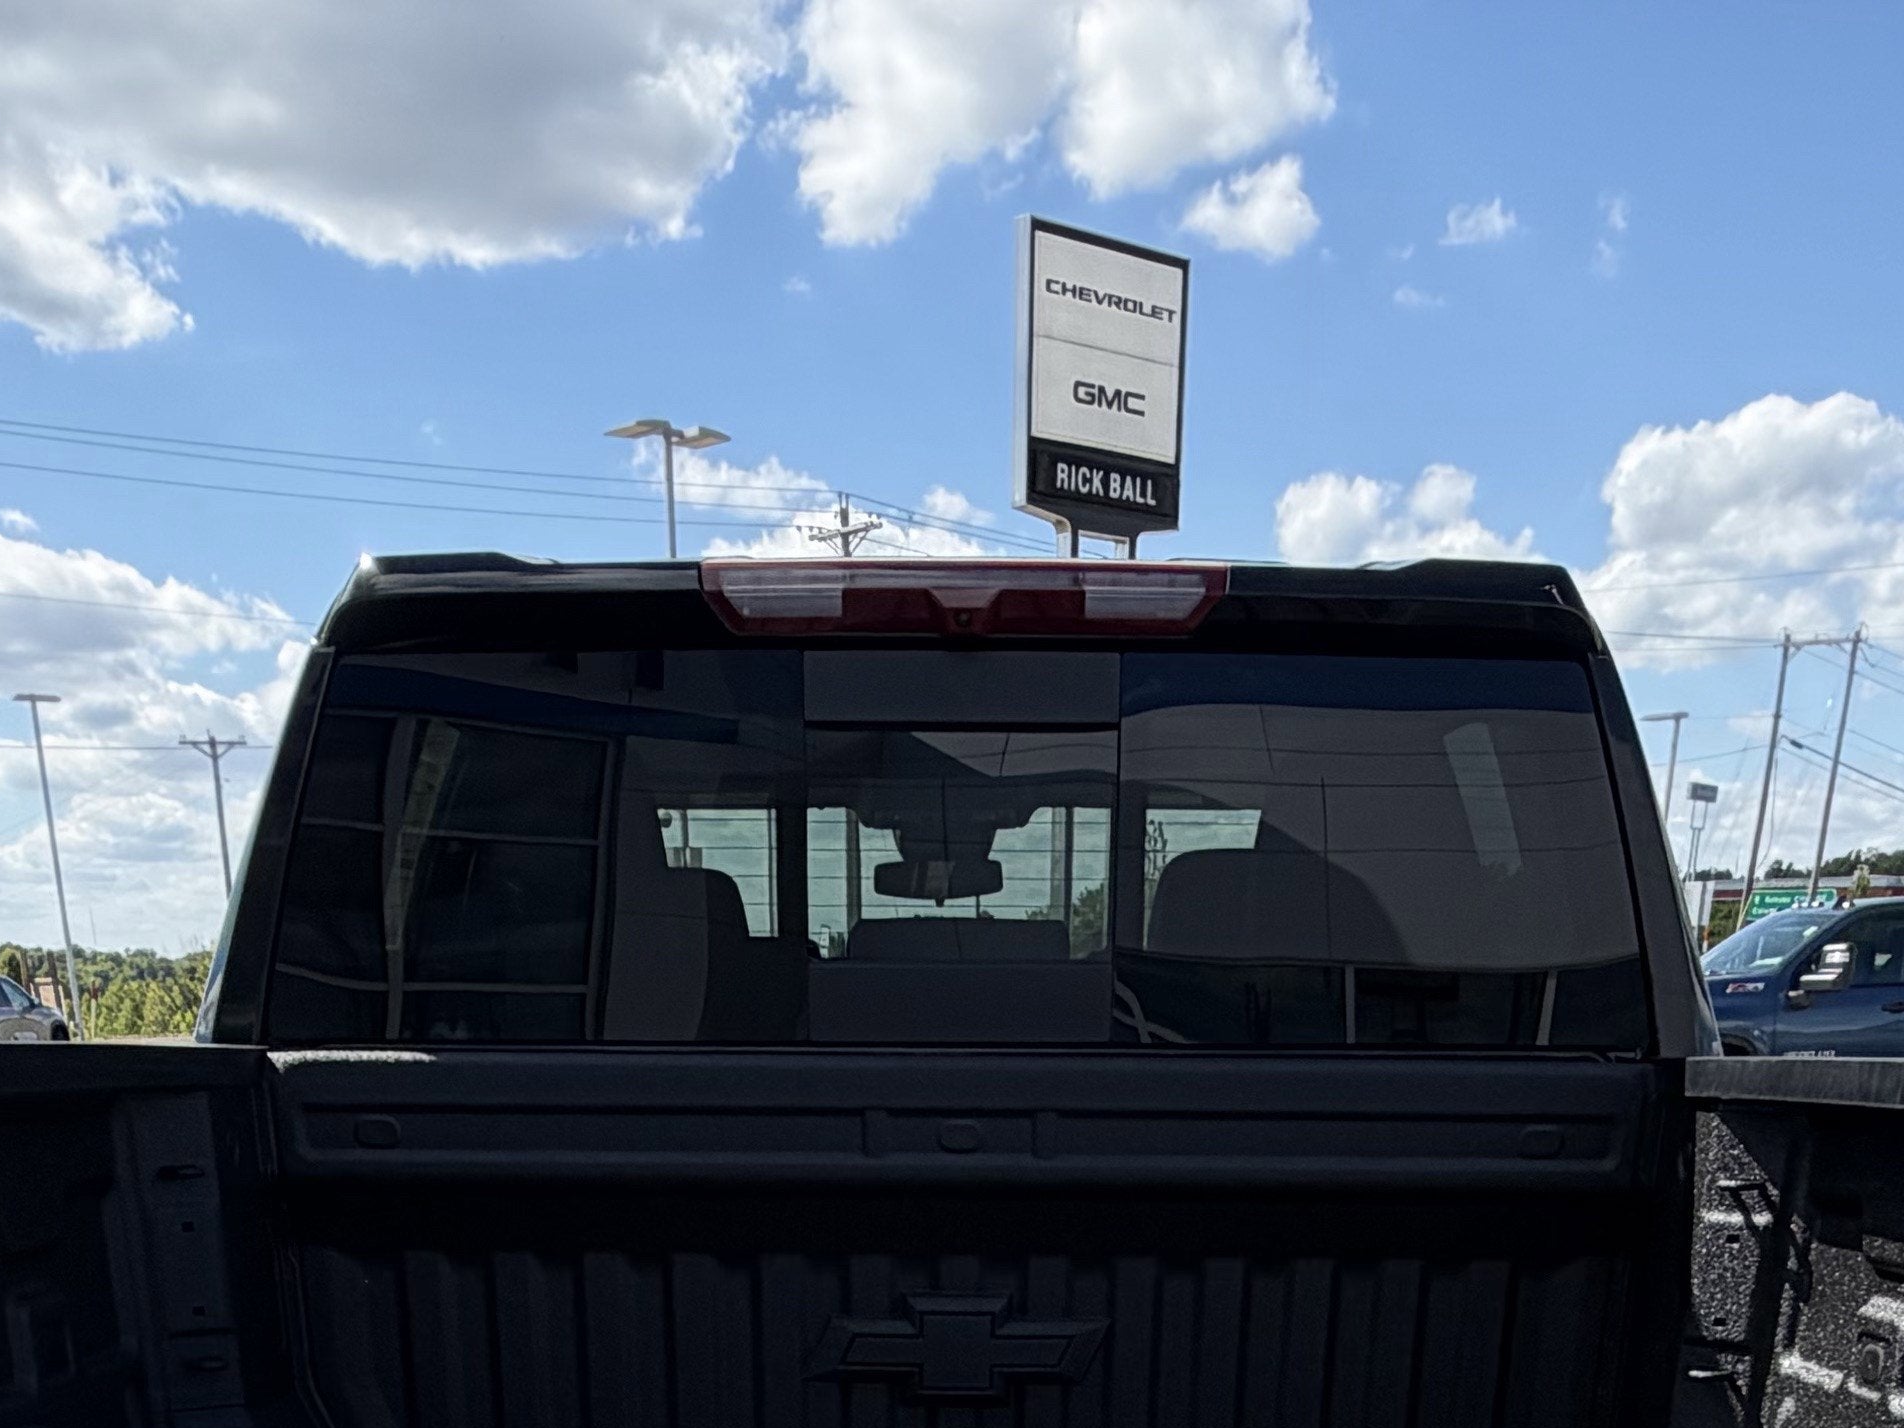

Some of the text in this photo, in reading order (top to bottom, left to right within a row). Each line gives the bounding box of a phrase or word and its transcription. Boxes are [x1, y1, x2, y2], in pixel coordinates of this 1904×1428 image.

[1045, 278, 1177, 323] CHEVROLET
[1072, 379, 1146, 418] GMC
[1056, 462, 1157, 507] RICK BALL
